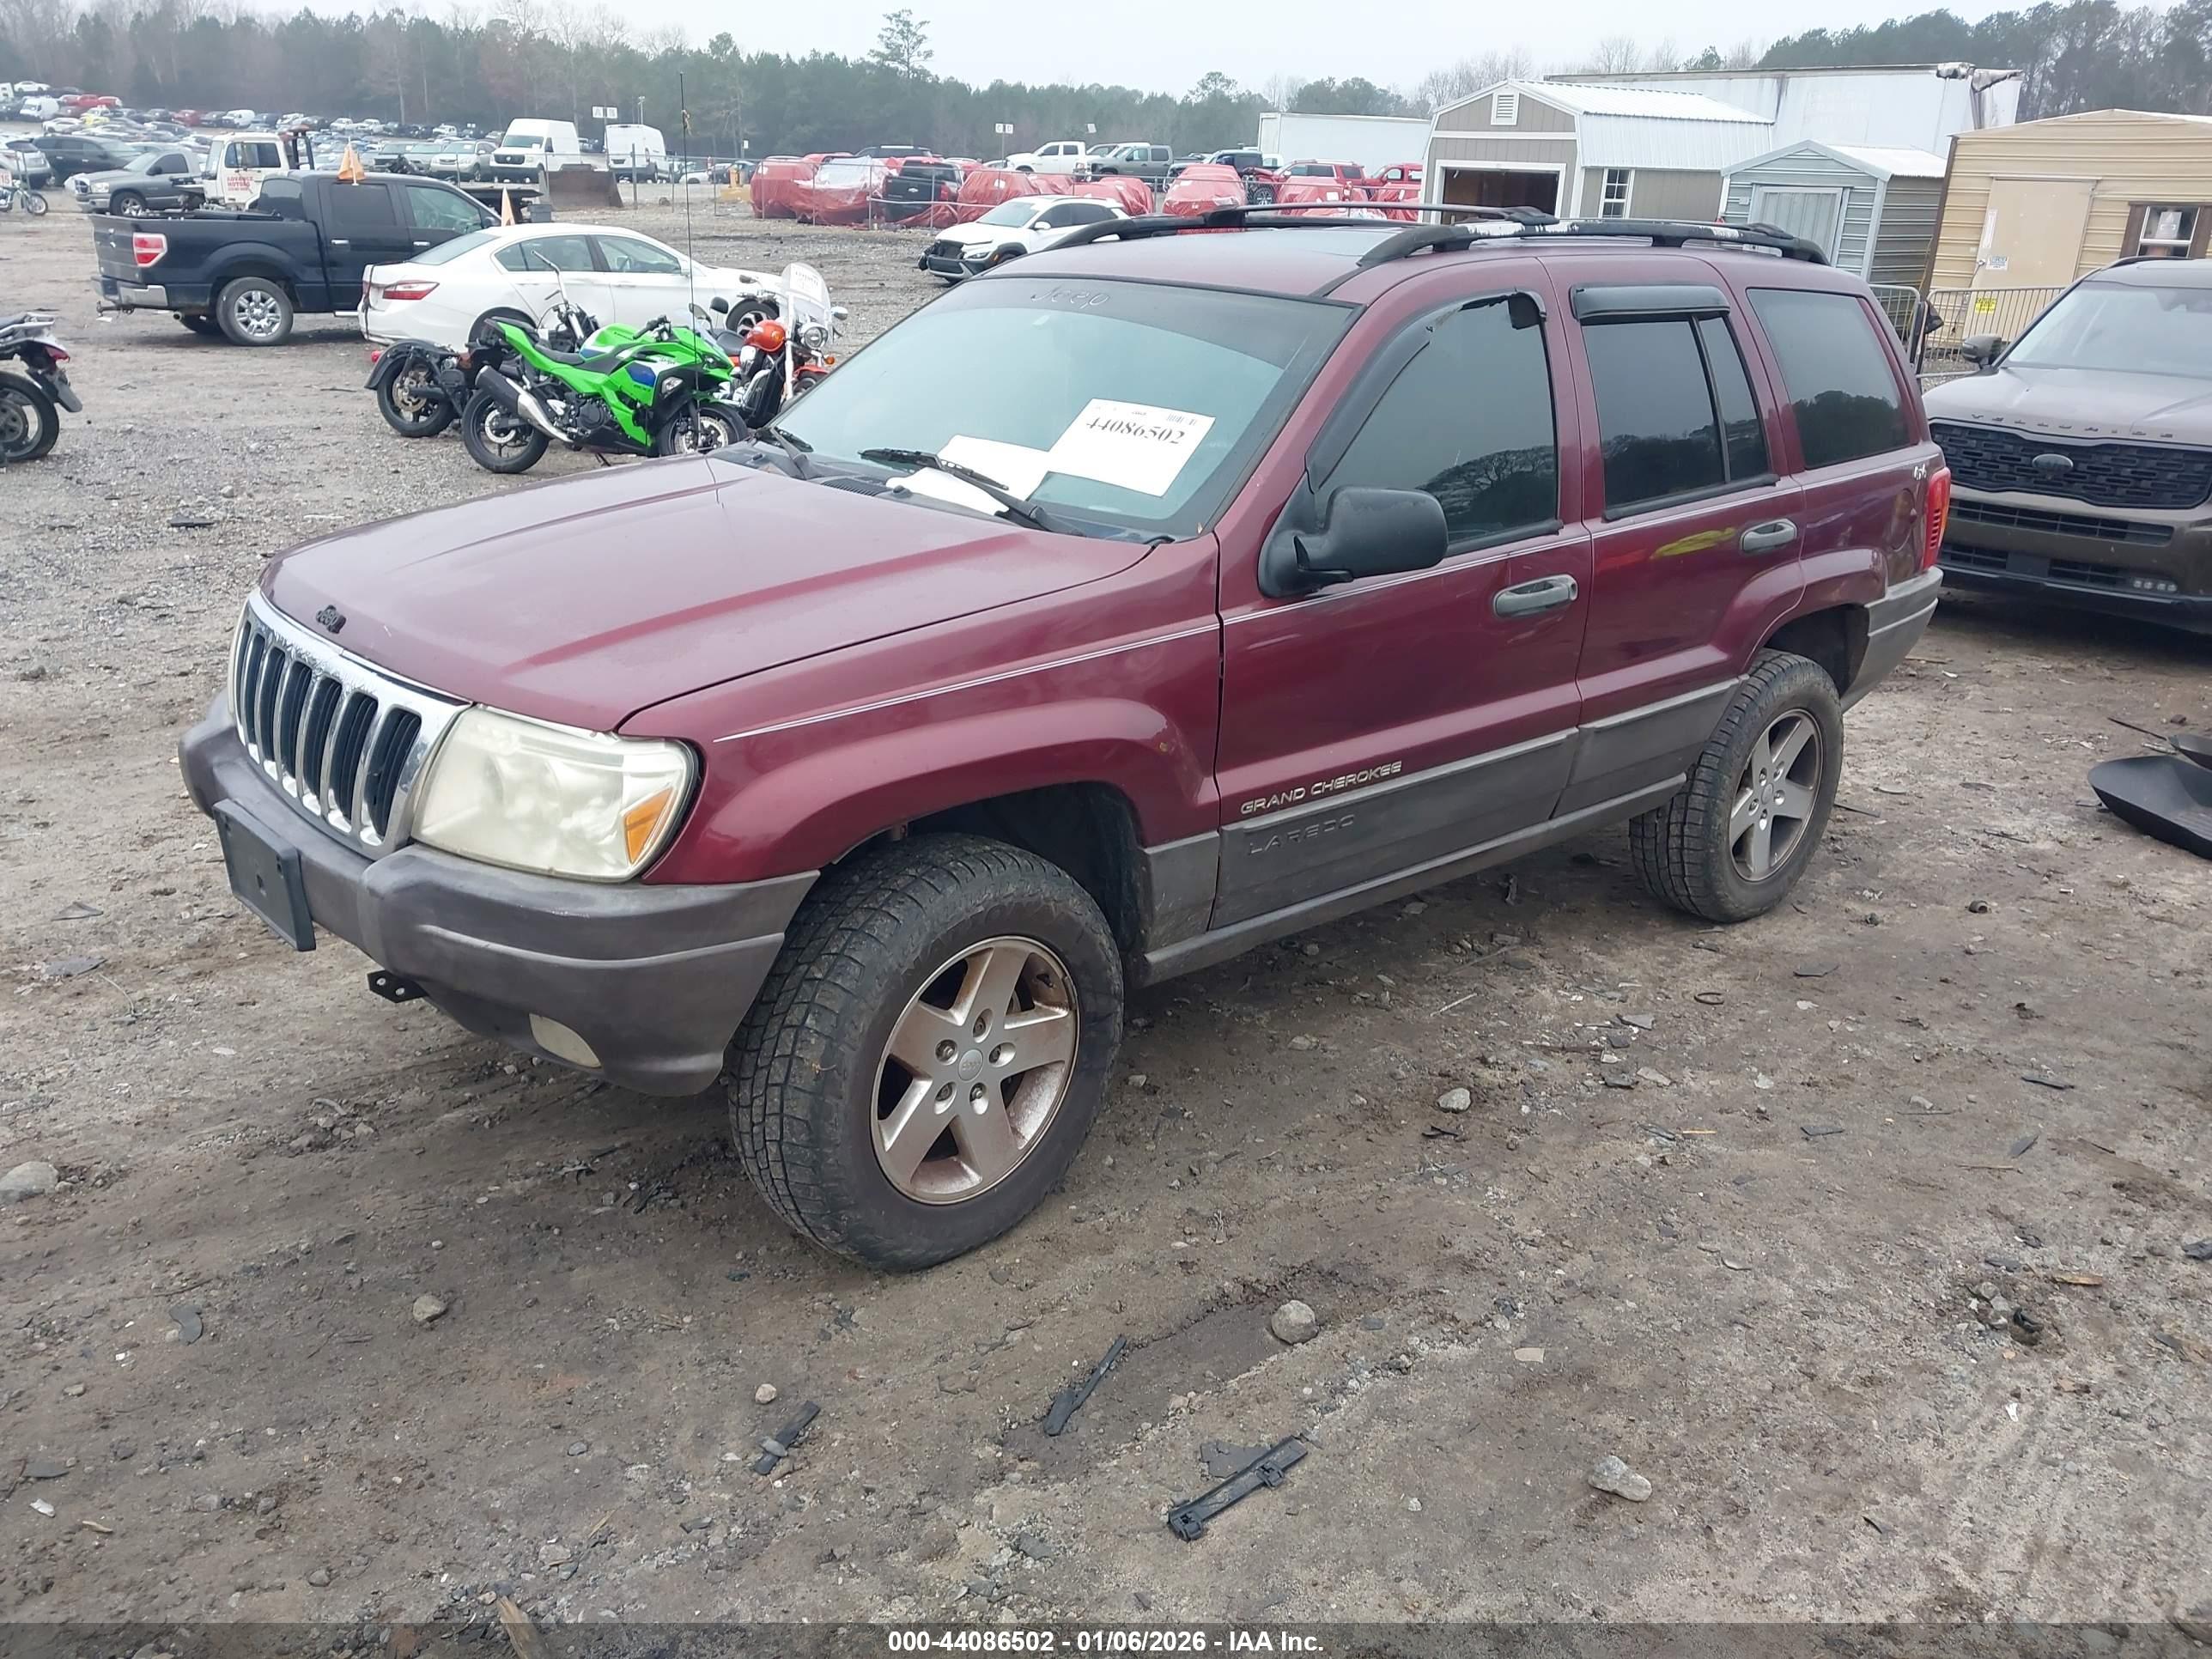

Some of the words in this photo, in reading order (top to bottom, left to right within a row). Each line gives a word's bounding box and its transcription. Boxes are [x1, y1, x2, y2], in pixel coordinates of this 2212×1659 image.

[1086, 417, 1186, 445] 44086502
[1240, 787, 1306, 815] GRAND
[1310, 760, 1402, 796] CHEROKEE
[1249, 814, 1354, 854] LAREDO
